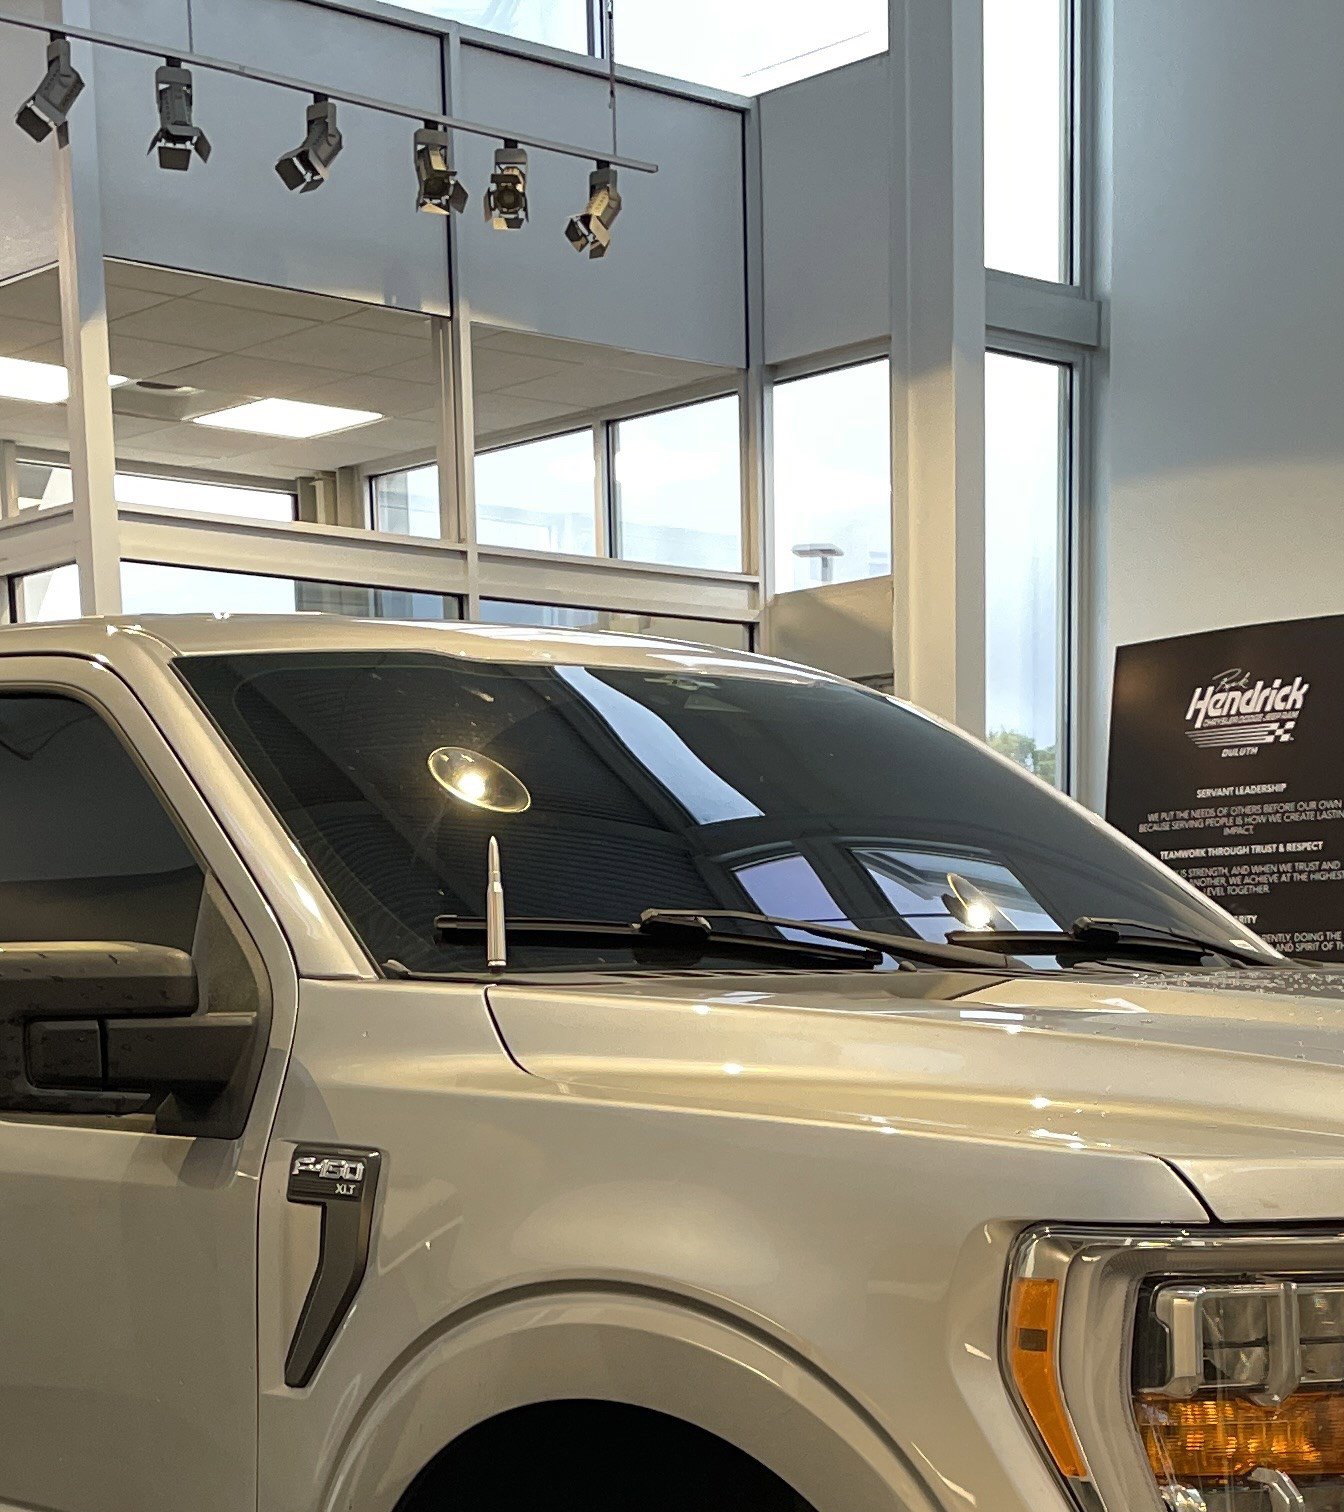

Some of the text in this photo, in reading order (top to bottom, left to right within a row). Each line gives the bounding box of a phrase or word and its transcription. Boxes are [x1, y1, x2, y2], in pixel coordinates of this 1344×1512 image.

[1185, 676, 1309, 729] Hendrick
[1221, 746, 1259, 758] DULUTH
[1196, 783, 1287, 798] SERVANT LEADERSHIP
[1296, 801, 1316, 811] OUR
[1318, 799, 1342, 809] OWN
[1244, 813, 1267, 824] HOW
[1267, 812, 1282, 823] WE
[1283, 811, 1316, 822] CREATE
[1160, 841, 1324, 860] TEAMWORK THROUGH TRUST & RESPECT
[1231, 865, 1250, 875] AND
[1251, 863, 1278, 874] WHEN
[1279, 862, 1293, 872] WE
[1294, 861, 1320, 871] TRUST
[1320, 860, 1341, 870] AND
[1229, 876, 1242, 886] WE
[1243, 873, 1279, 884] ACHIEVE
[1280, 872, 1291, 882] AT
[1292, 871, 1309, 882] THE
[1294, 932, 1324, 942] DOING
[1325, 931, 1342, 941] THE
[1276, 943, 1294, 953] AND
[1295, 942, 1320, 952] SPIRIT
[1321, 941, 1333, 951] OF
[292, 1157, 365, 1182] F-150
[335, 1183, 356, 1196] XLT
